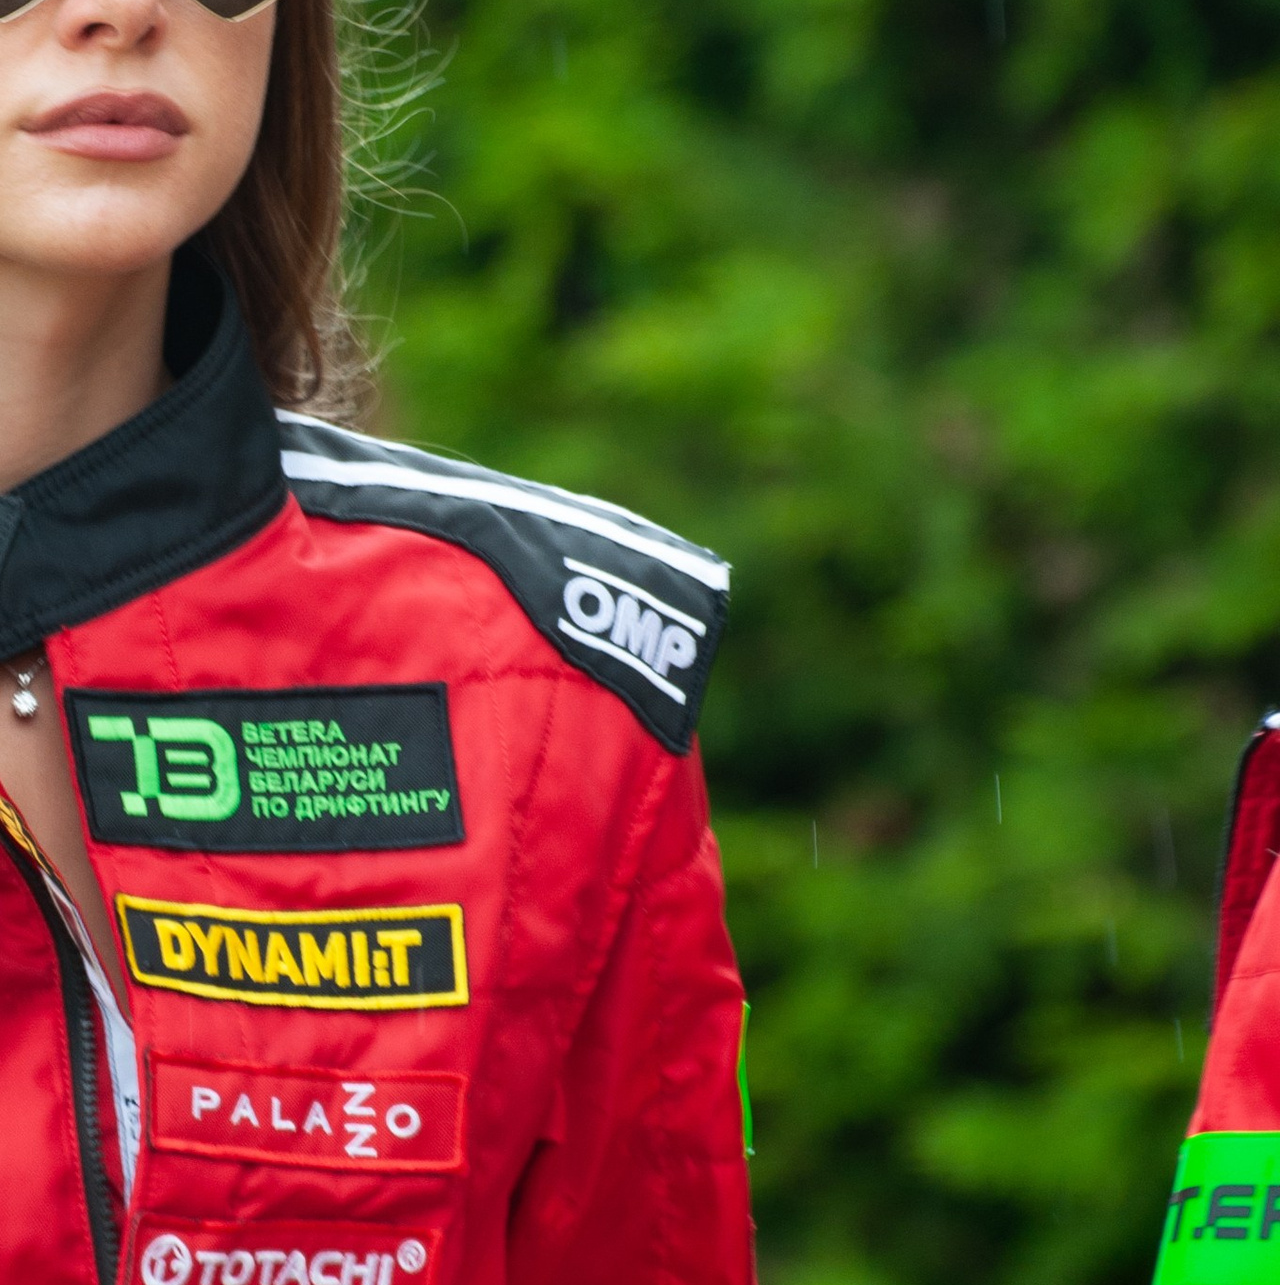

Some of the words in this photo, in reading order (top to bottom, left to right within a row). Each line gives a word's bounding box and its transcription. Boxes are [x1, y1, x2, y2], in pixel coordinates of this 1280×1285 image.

[563, 576, 697, 677] OMP
[244, 741, 402, 769] ЧЕМПИОНАТ
[248, 767, 387, 794] БЕЛАРУСИ
[251, 795, 289, 819] ПО
[294, 789, 451, 822] ДРИФТИНГУ
